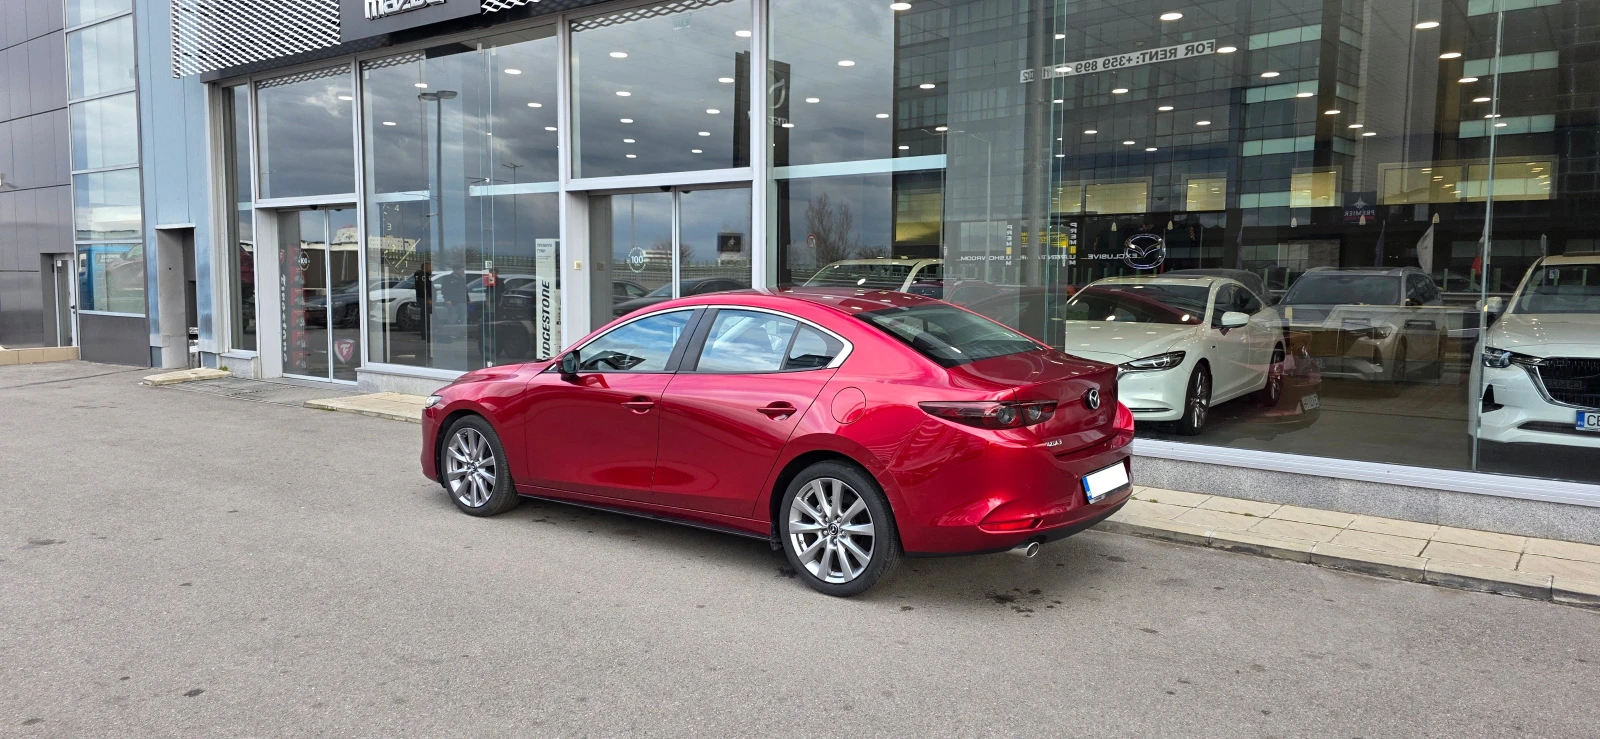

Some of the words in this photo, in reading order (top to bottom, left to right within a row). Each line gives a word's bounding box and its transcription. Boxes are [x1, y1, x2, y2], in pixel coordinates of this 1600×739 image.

[364, 0, 445, 20] maz
[387, 223, 392, 231] 3
[631, 255, 644, 264] 100
[542, 280, 551, 358] IDGESTONE
